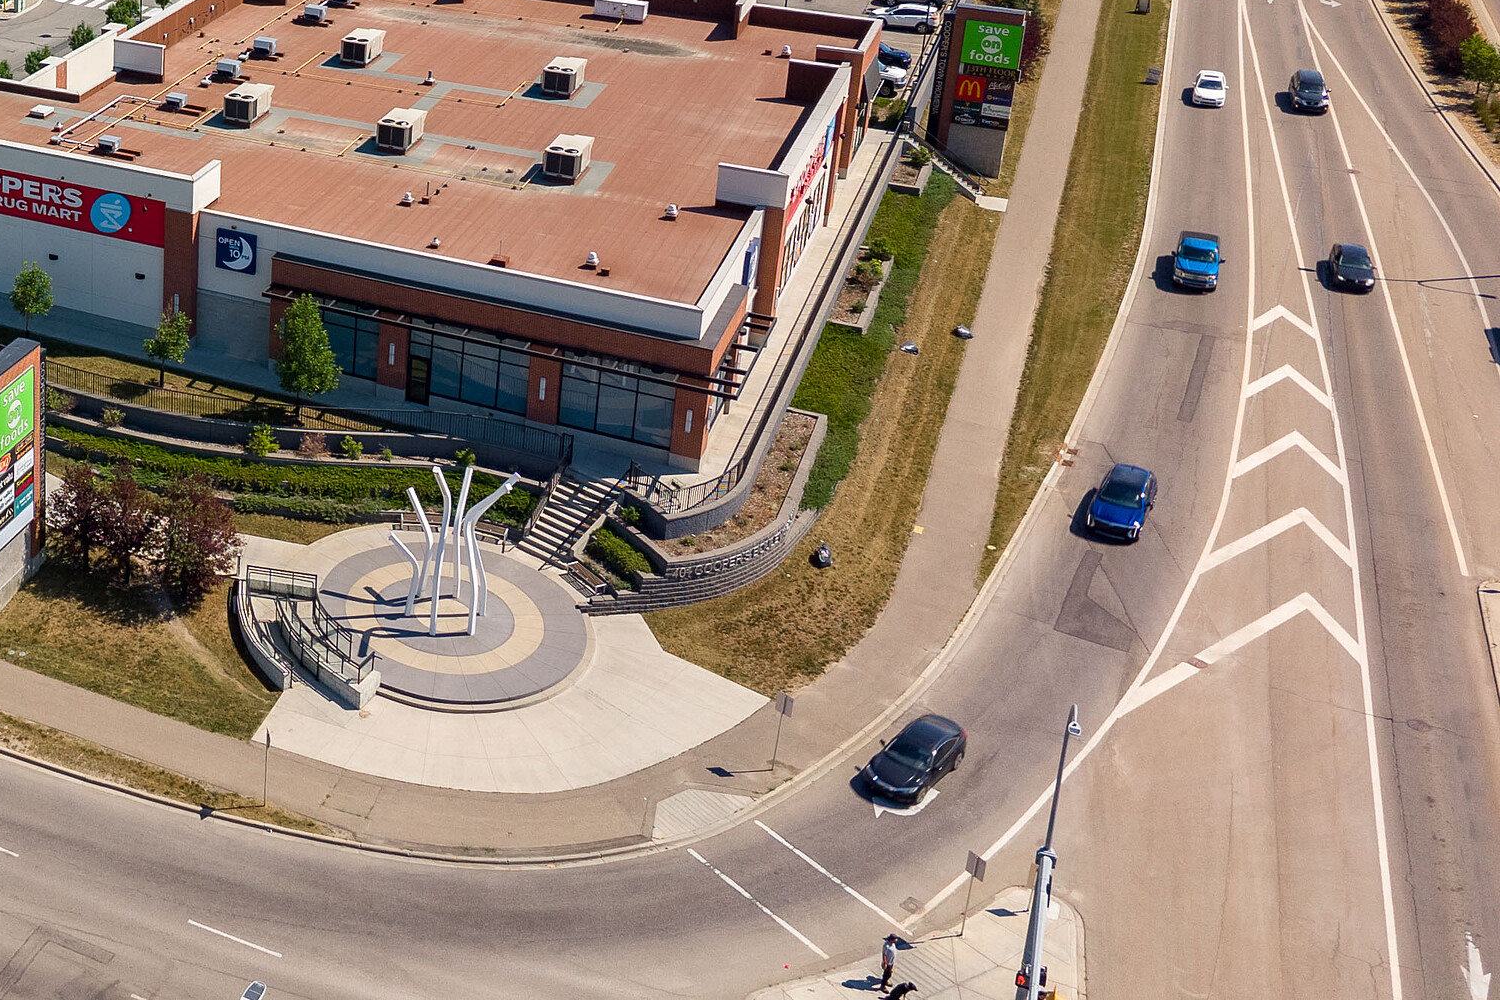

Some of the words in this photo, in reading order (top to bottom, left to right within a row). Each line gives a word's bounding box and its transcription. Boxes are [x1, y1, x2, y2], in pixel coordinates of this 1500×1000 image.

[978, 24, 1010, 36] save
[981, 38, 1000, 49] on
[969, 49, 1010, 65] foods
[32, 202, 82, 222] MART
[218, 236, 240, 247] OPEN
[229, 249, 241, 258] 10
[3, 381, 26, 407] save
[0, 419, 29, 451] foods
